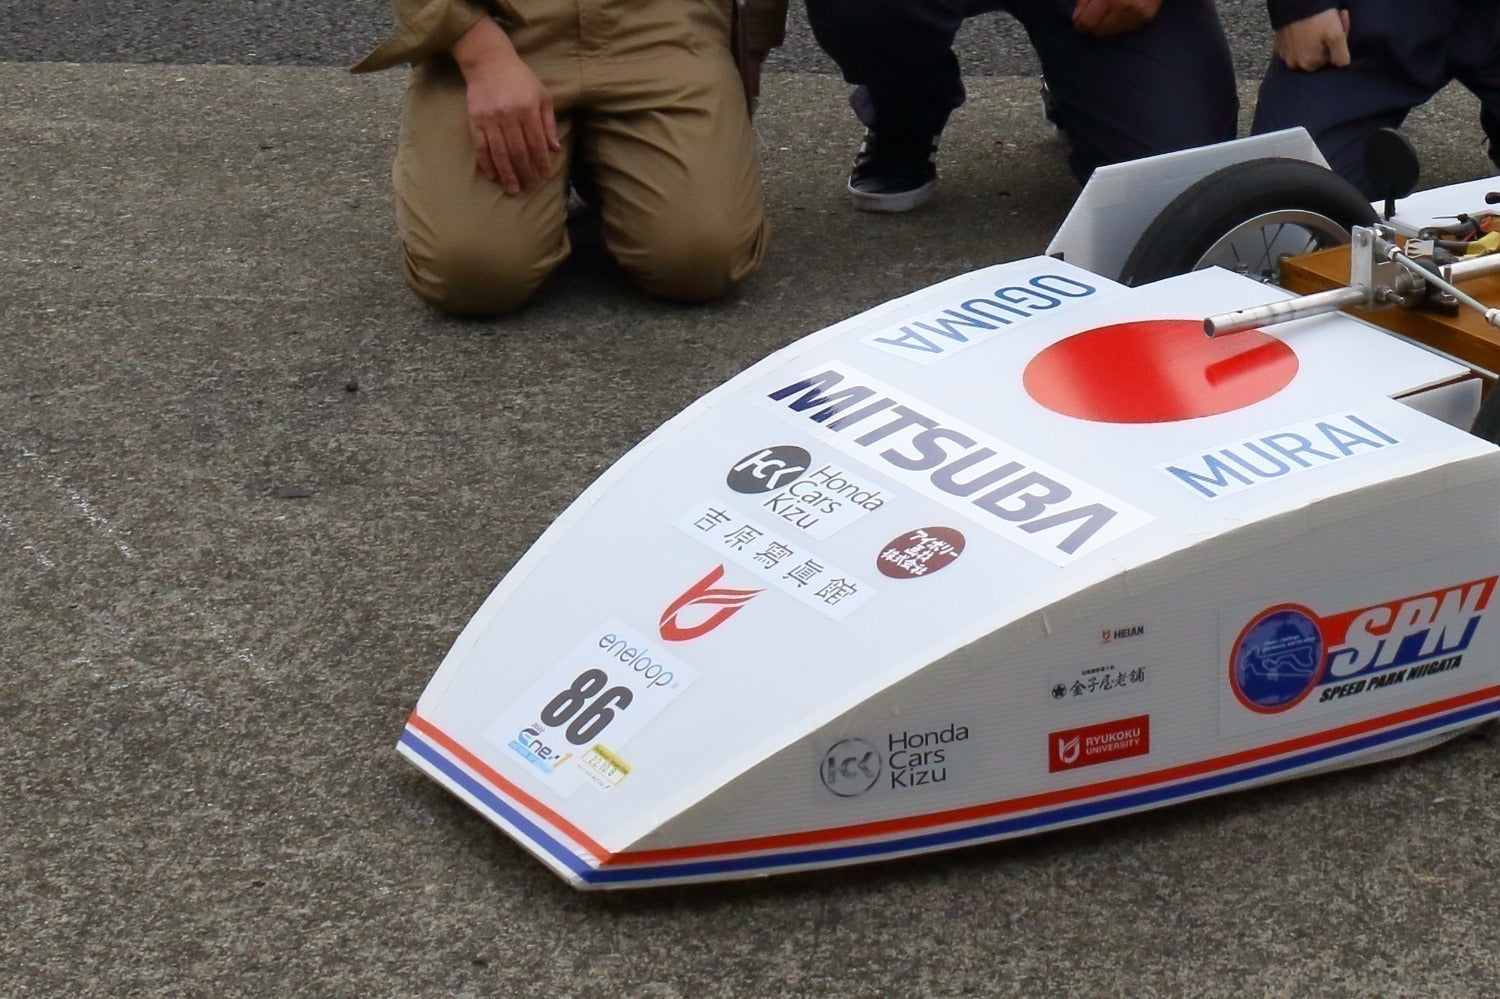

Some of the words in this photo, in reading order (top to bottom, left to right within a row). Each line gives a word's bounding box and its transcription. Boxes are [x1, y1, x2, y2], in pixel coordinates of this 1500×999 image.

[873, 274, 1097, 354] OGUMA
[766, 369, 1118, 556] MITSUBA
[1166, 413, 1401, 499] MURAI
[789, 480, 842, 514] Cars
[809, 465, 884, 512] Honda
[763, 493, 820, 529] Kizu
[1114, 626, 1144, 640] HEIAN
[1328, 582, 1487, 678] SPN
[599, 632, 673, 689] eneloop
[1319, 679, 1366, 703] SPEED
[1366, 669, 1407, 691] PARK
[1406, 655, 1463, 681] NIIGATA
[540, 668, 633, 746] 86
[889, 723, 969, 751] Honda
[1086, 728, 1141, 747] RYUKOKU
[1086, 738, 1140, 755] UNIVERSITY
[889, 749, 945, 770] Cars
[891, 768, 946, 789] Kizu
